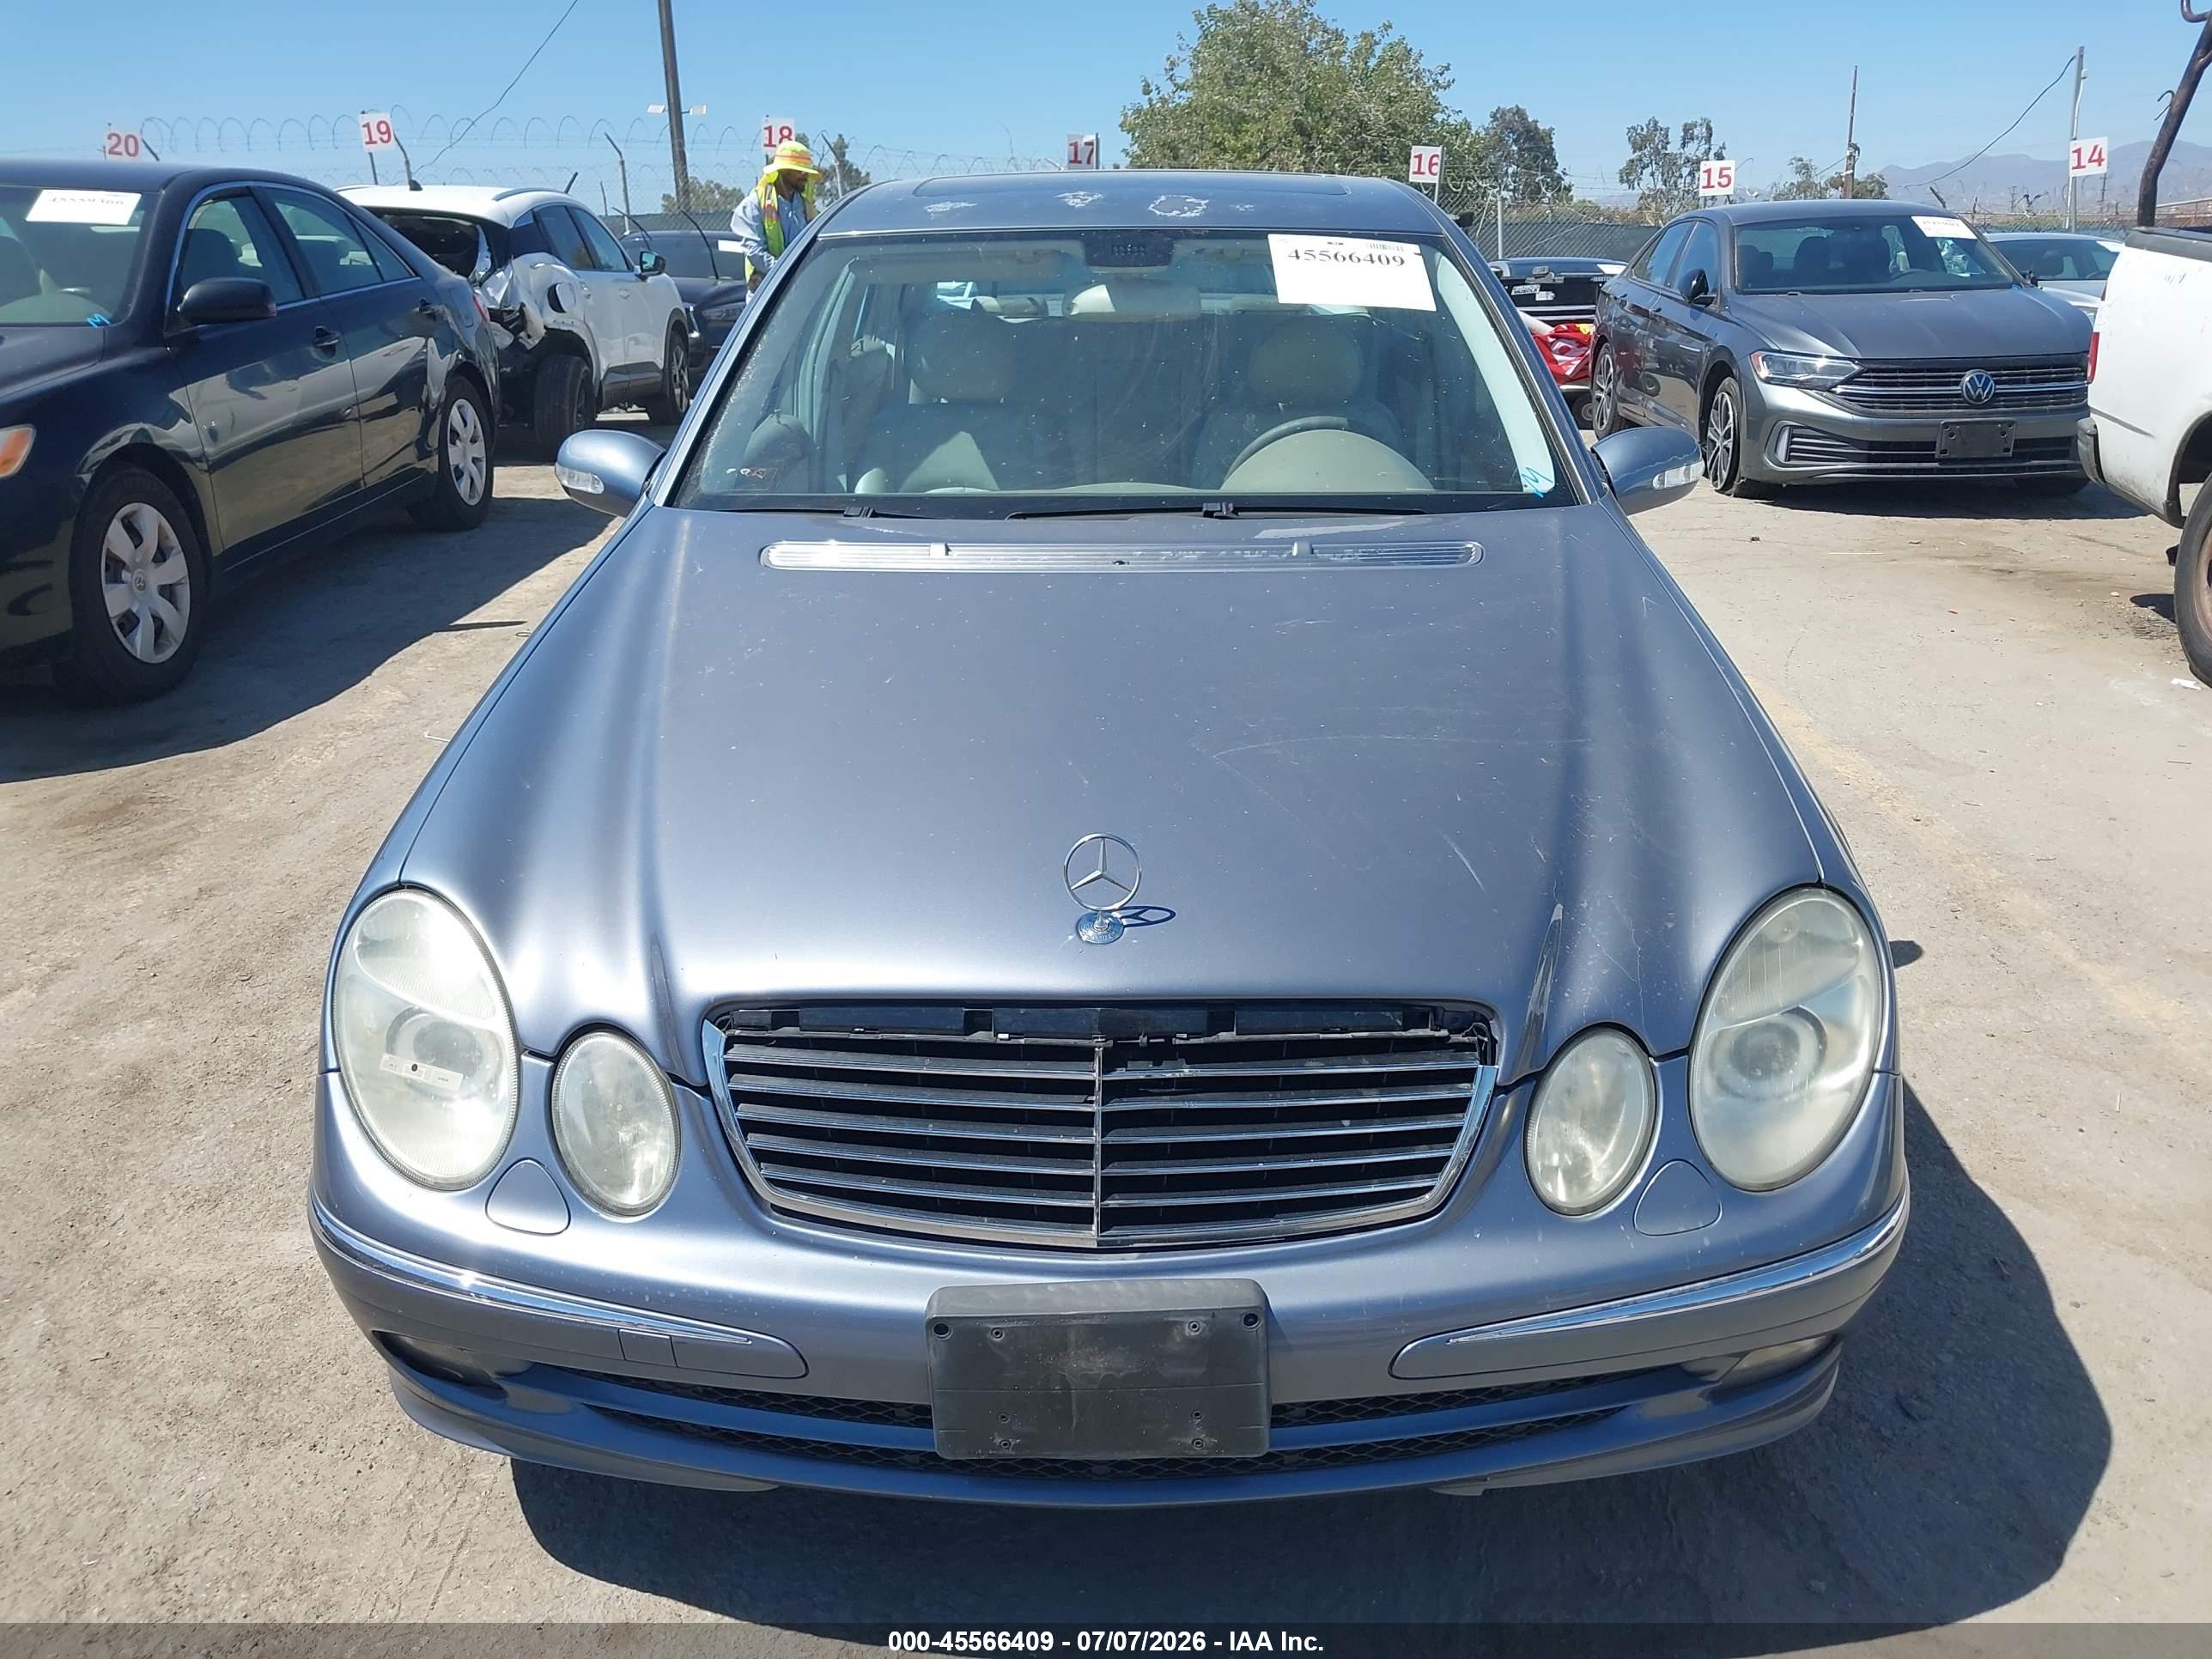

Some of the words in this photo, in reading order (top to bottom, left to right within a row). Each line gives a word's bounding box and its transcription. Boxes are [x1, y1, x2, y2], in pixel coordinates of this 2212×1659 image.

[107, 132, 139, 156] 20
[362, 120, 392, 145] 19
[763, 125, 793, 147] 18
[1068, 141, 1094, 165] 17
[1412, 153, 1440, 176] 16
[2071, 143, 2105, 170] 14
[1702, 166, 1732, 189] 15
[1288, 248, 1405, 267] 45566409
